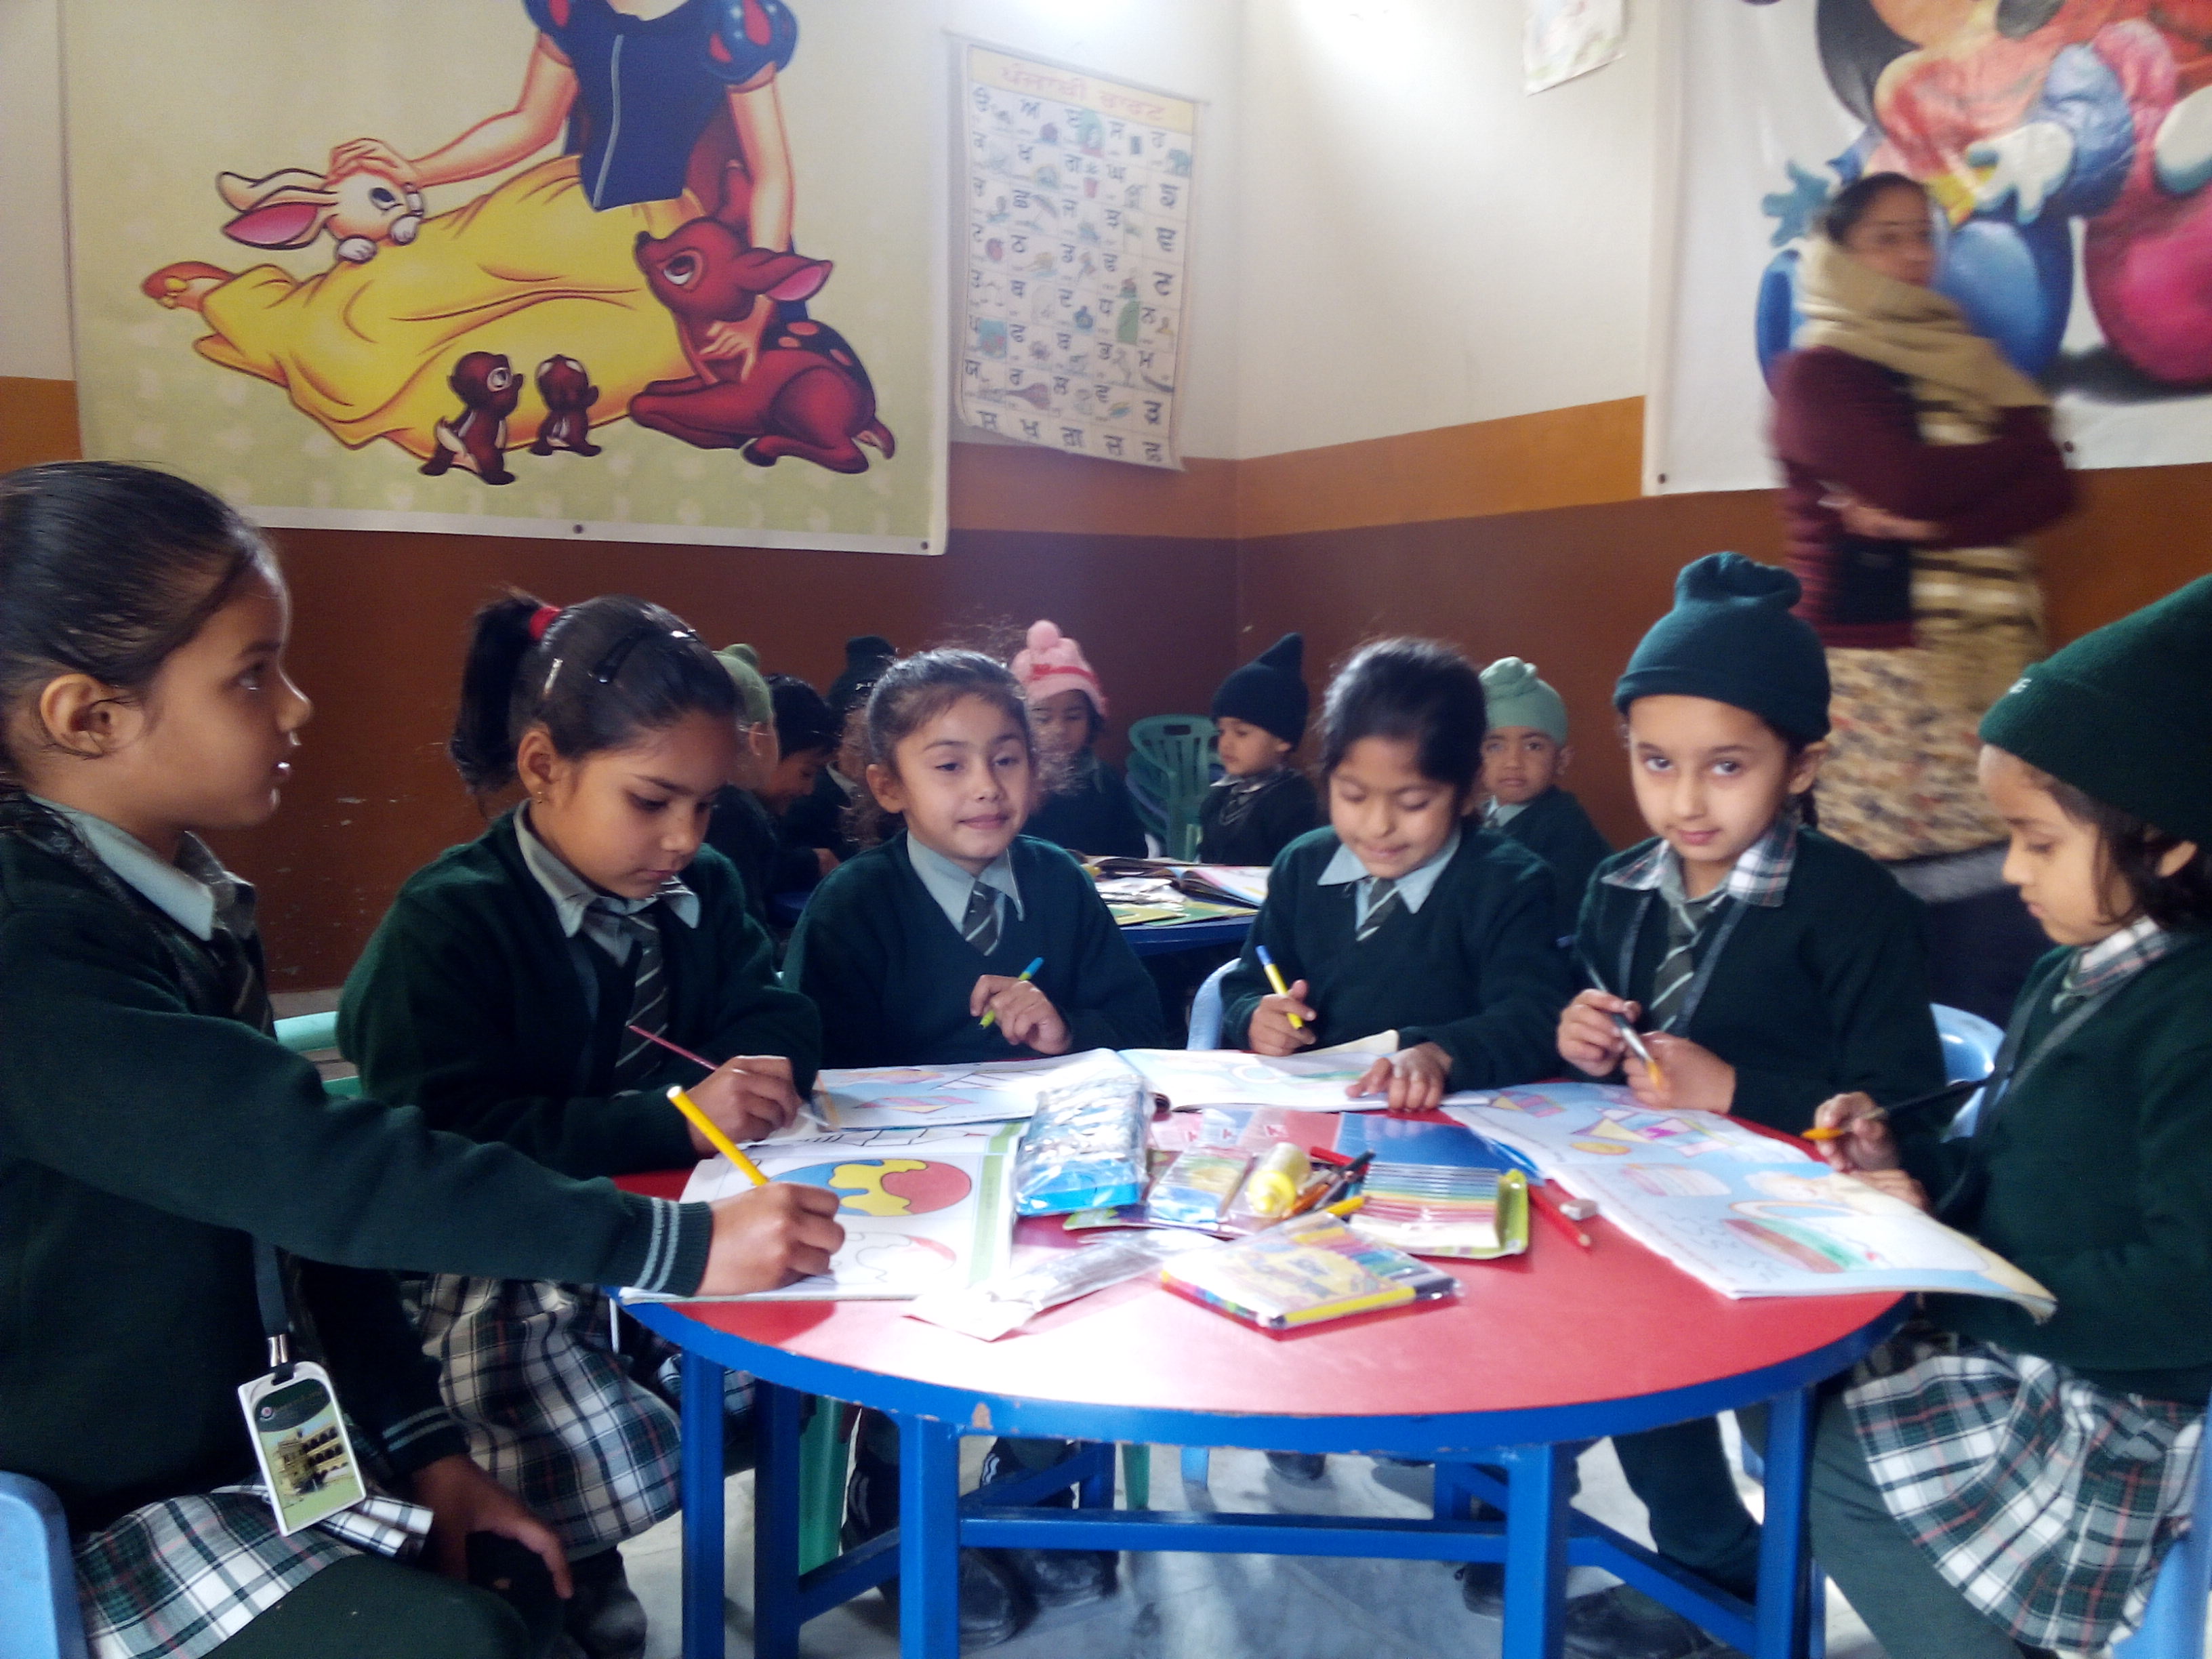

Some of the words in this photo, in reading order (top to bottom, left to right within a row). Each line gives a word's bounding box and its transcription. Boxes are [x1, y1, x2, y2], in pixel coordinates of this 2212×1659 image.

[1019, 100, 1040, 119] ਅ
[1065, 154, 1082, 172] ਗ
[1012, 190, 1031, 209] ਛ
